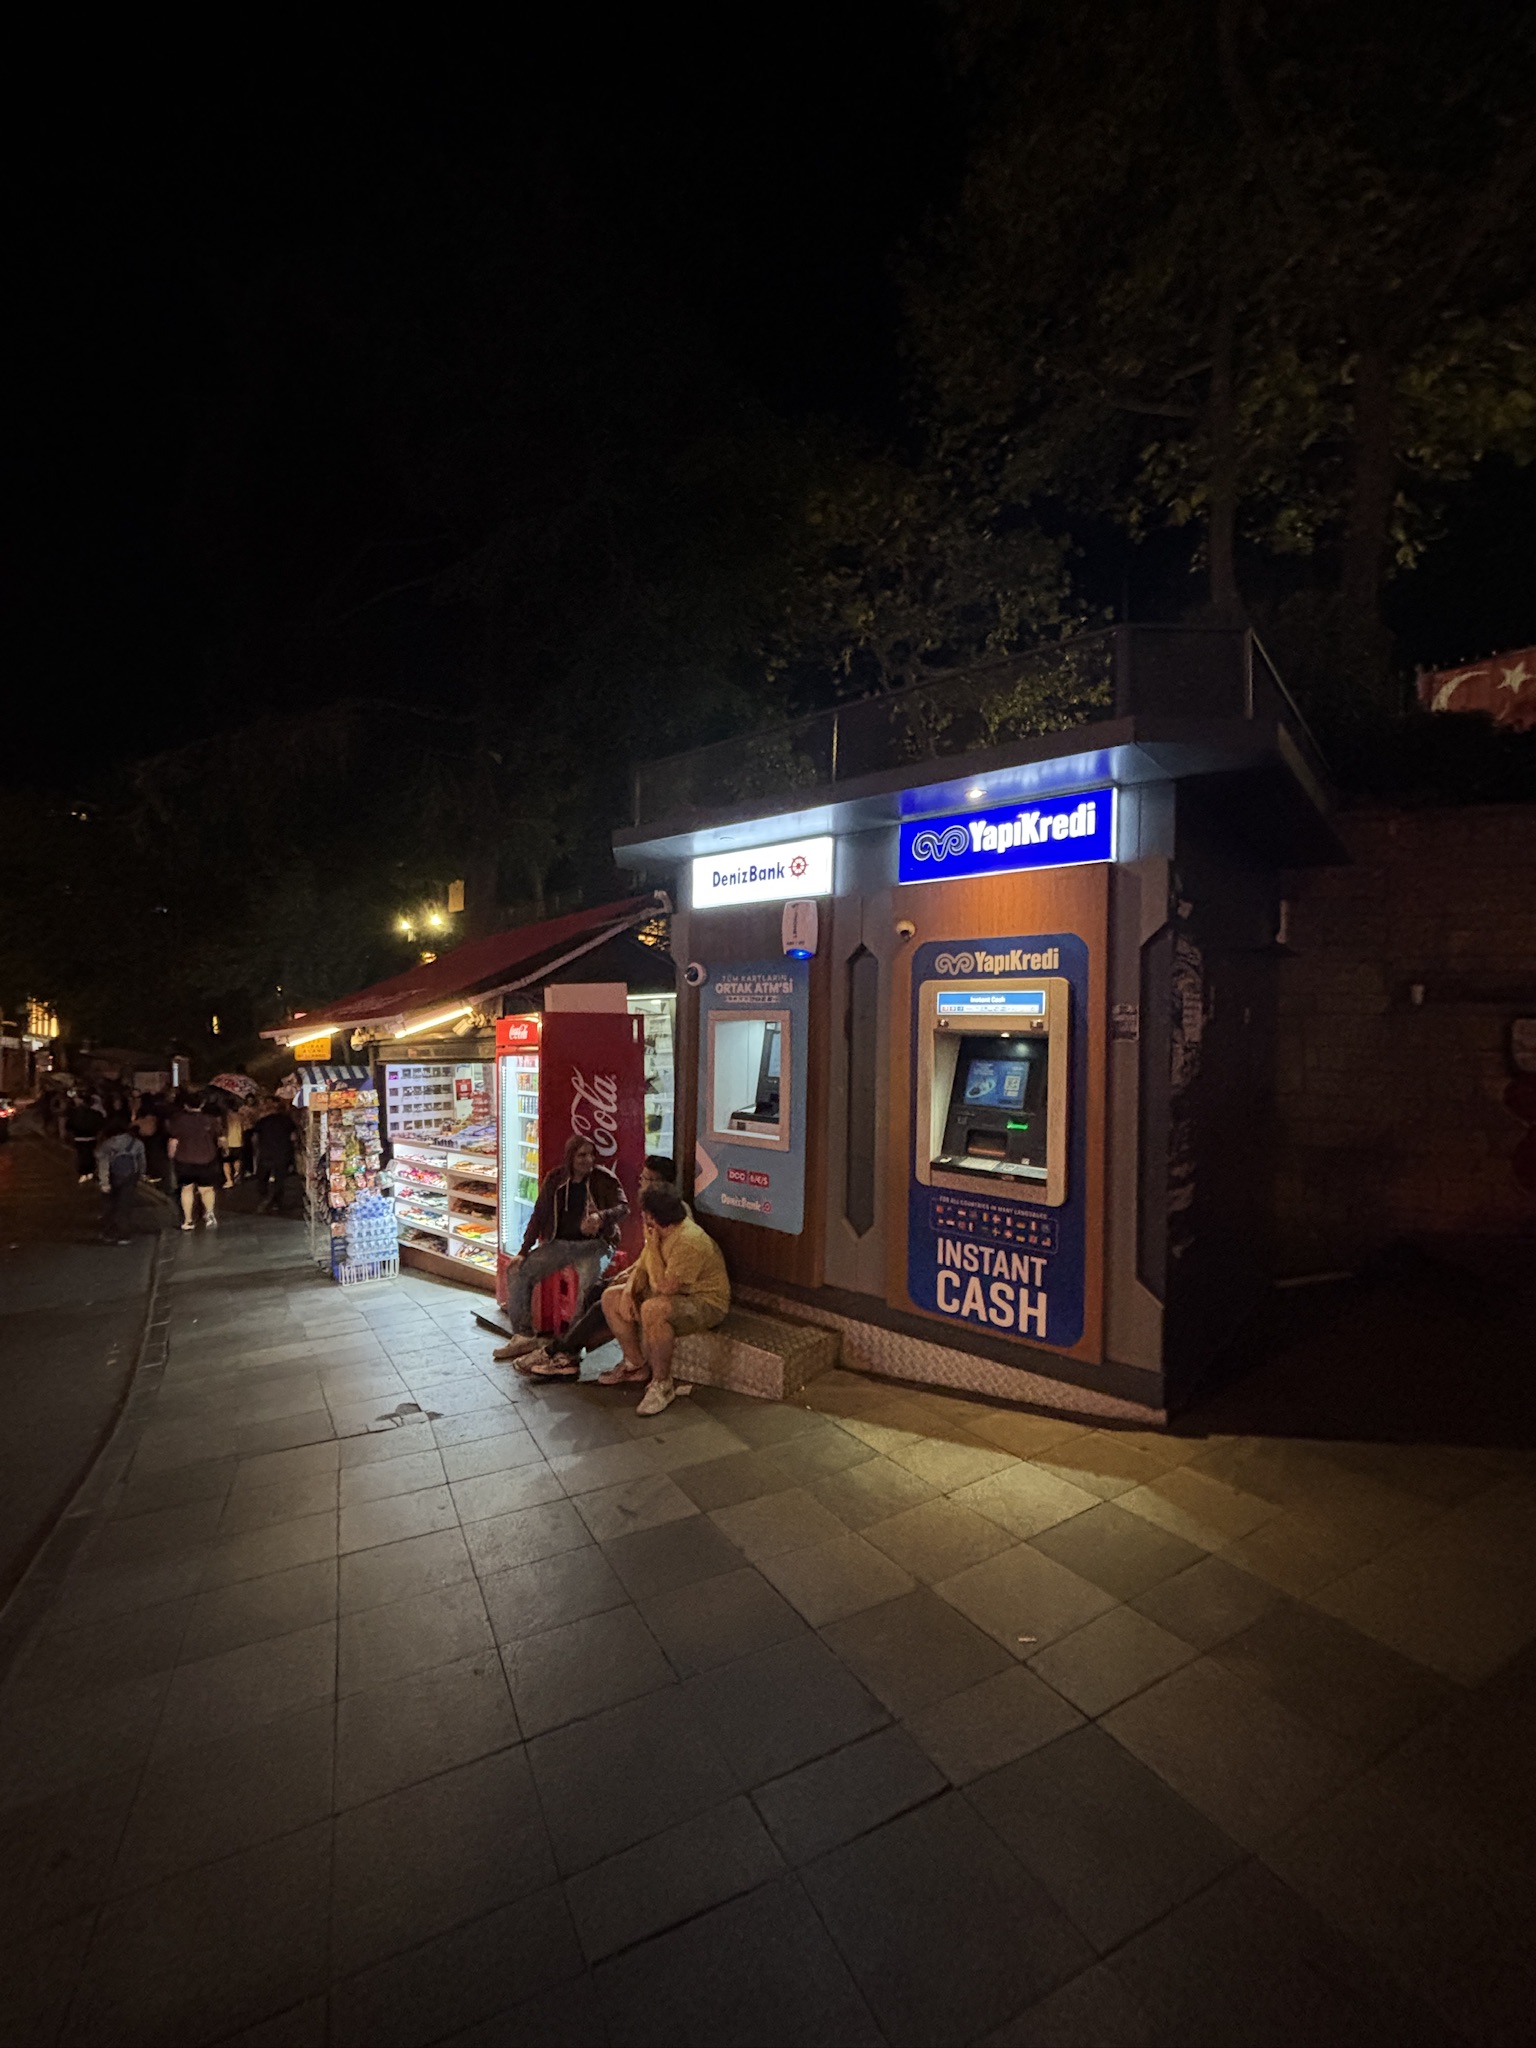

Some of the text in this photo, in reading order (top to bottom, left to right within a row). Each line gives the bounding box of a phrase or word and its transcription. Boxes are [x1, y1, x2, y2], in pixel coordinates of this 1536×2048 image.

[712, 861, 785, 888] DenizBank
[715, 982, 752, 994] ORTAK
[937, 1237, 1048, 1287] INSTANT
[936, 1269, 1048, 1338] CASH
